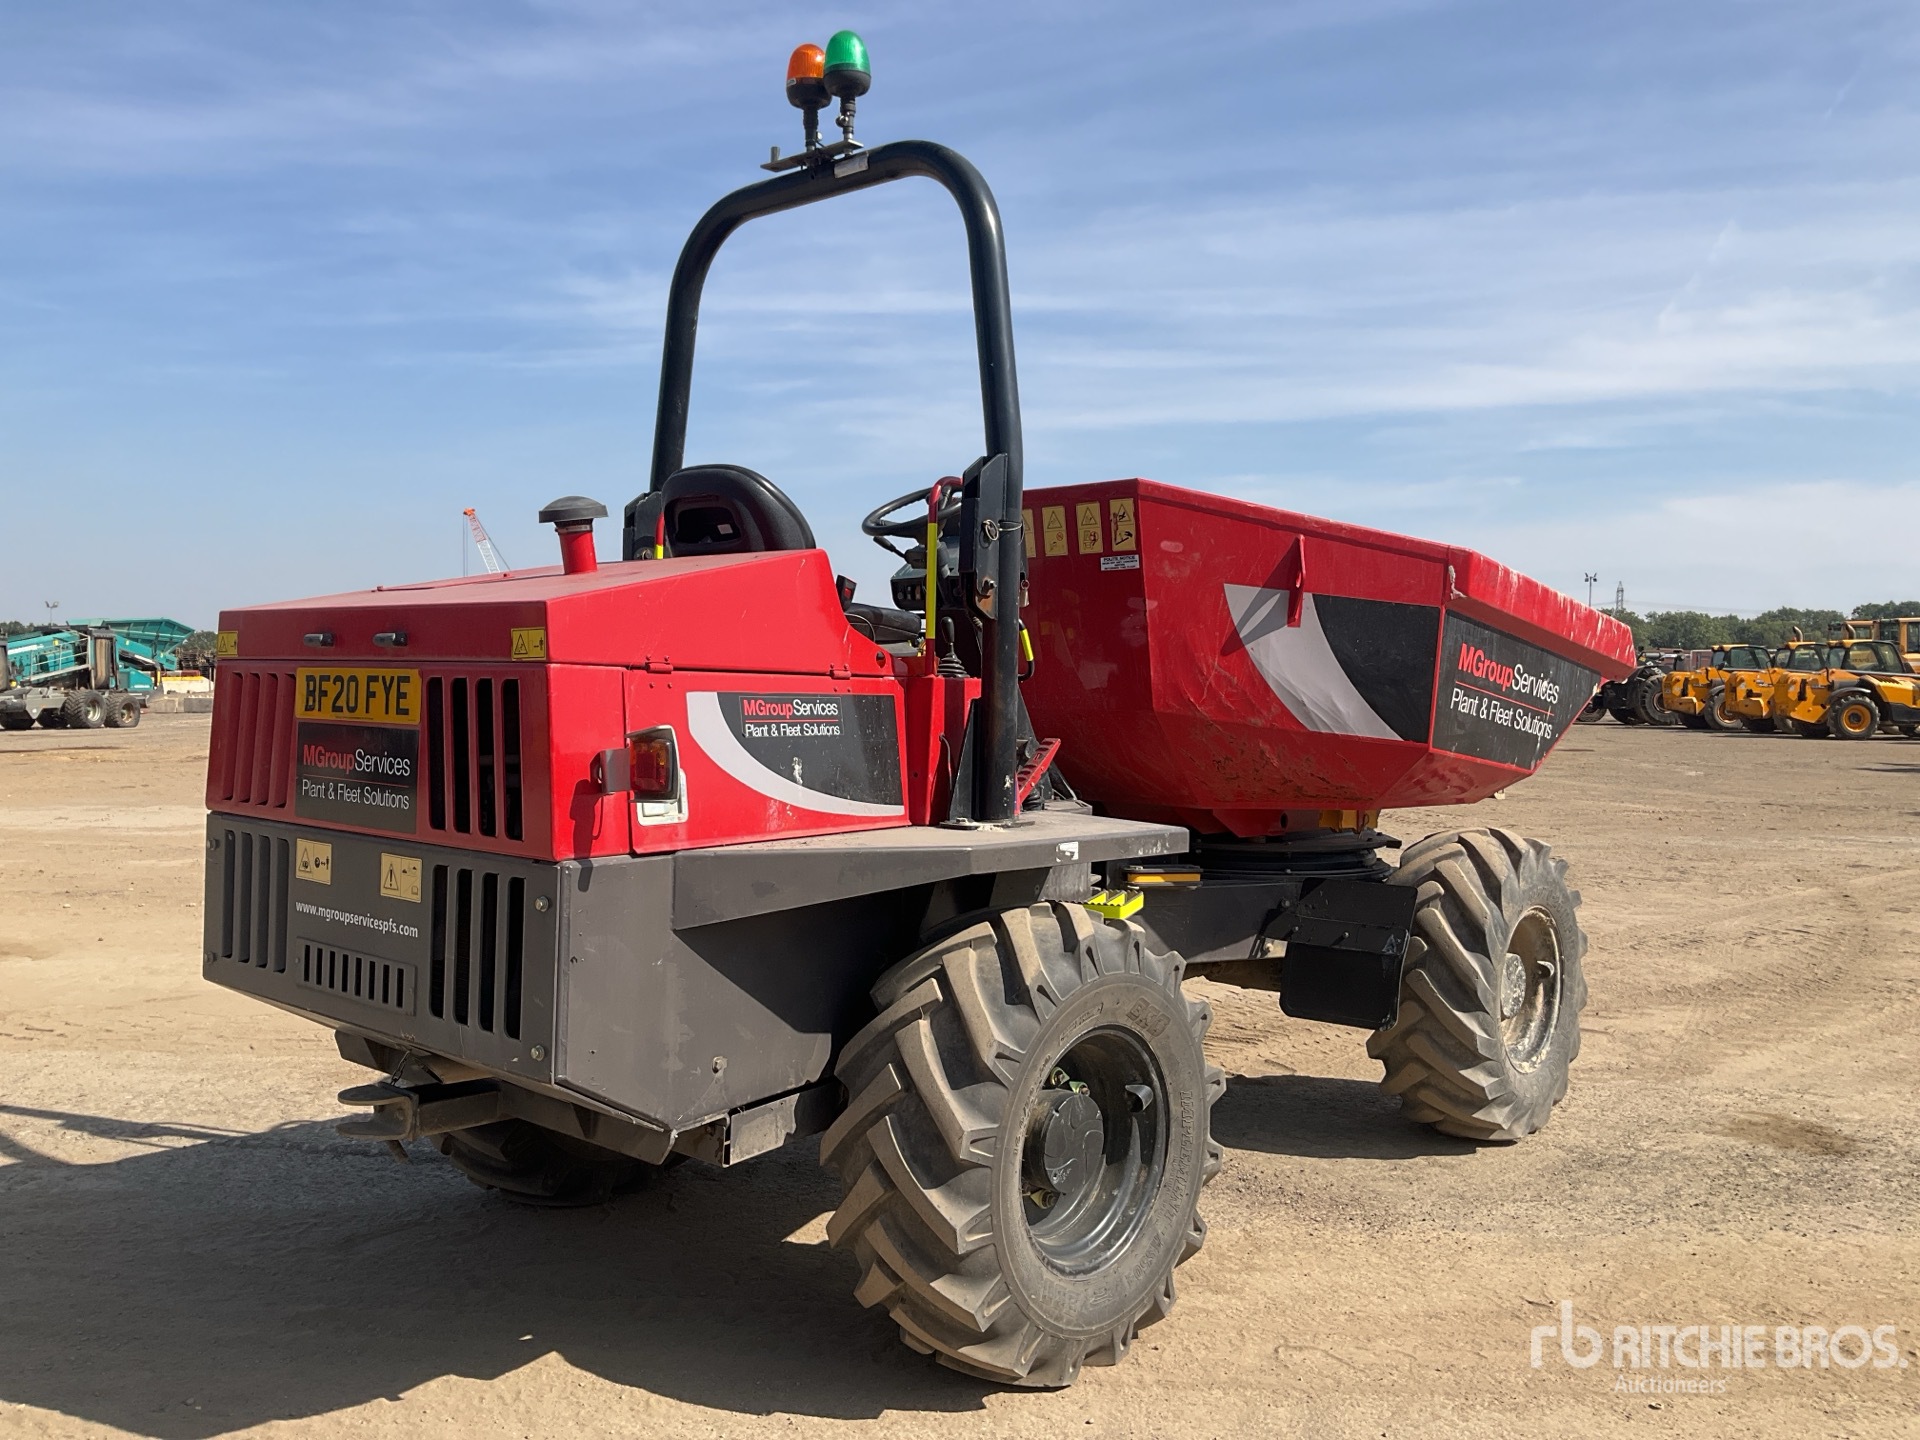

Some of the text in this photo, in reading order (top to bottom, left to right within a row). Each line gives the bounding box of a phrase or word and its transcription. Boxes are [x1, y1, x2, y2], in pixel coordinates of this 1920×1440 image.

[1458, 643, 1560, 704] MGroupServices
[304, 674, 411, 716] BF20 FYE
[743, 699, 839, 719] MGroupServices
[745, 722, 841, 737] Plant & Fleet Solutions
[1450, 687, 1553, 739] Plant & Fleet Solutions
[303, 744, 411, 777] MGroupServices
[302, 779, 410, 810] Plant & Fleet Solutions
[295, 901, 419, 938] www.mgroupservicespfs.com
